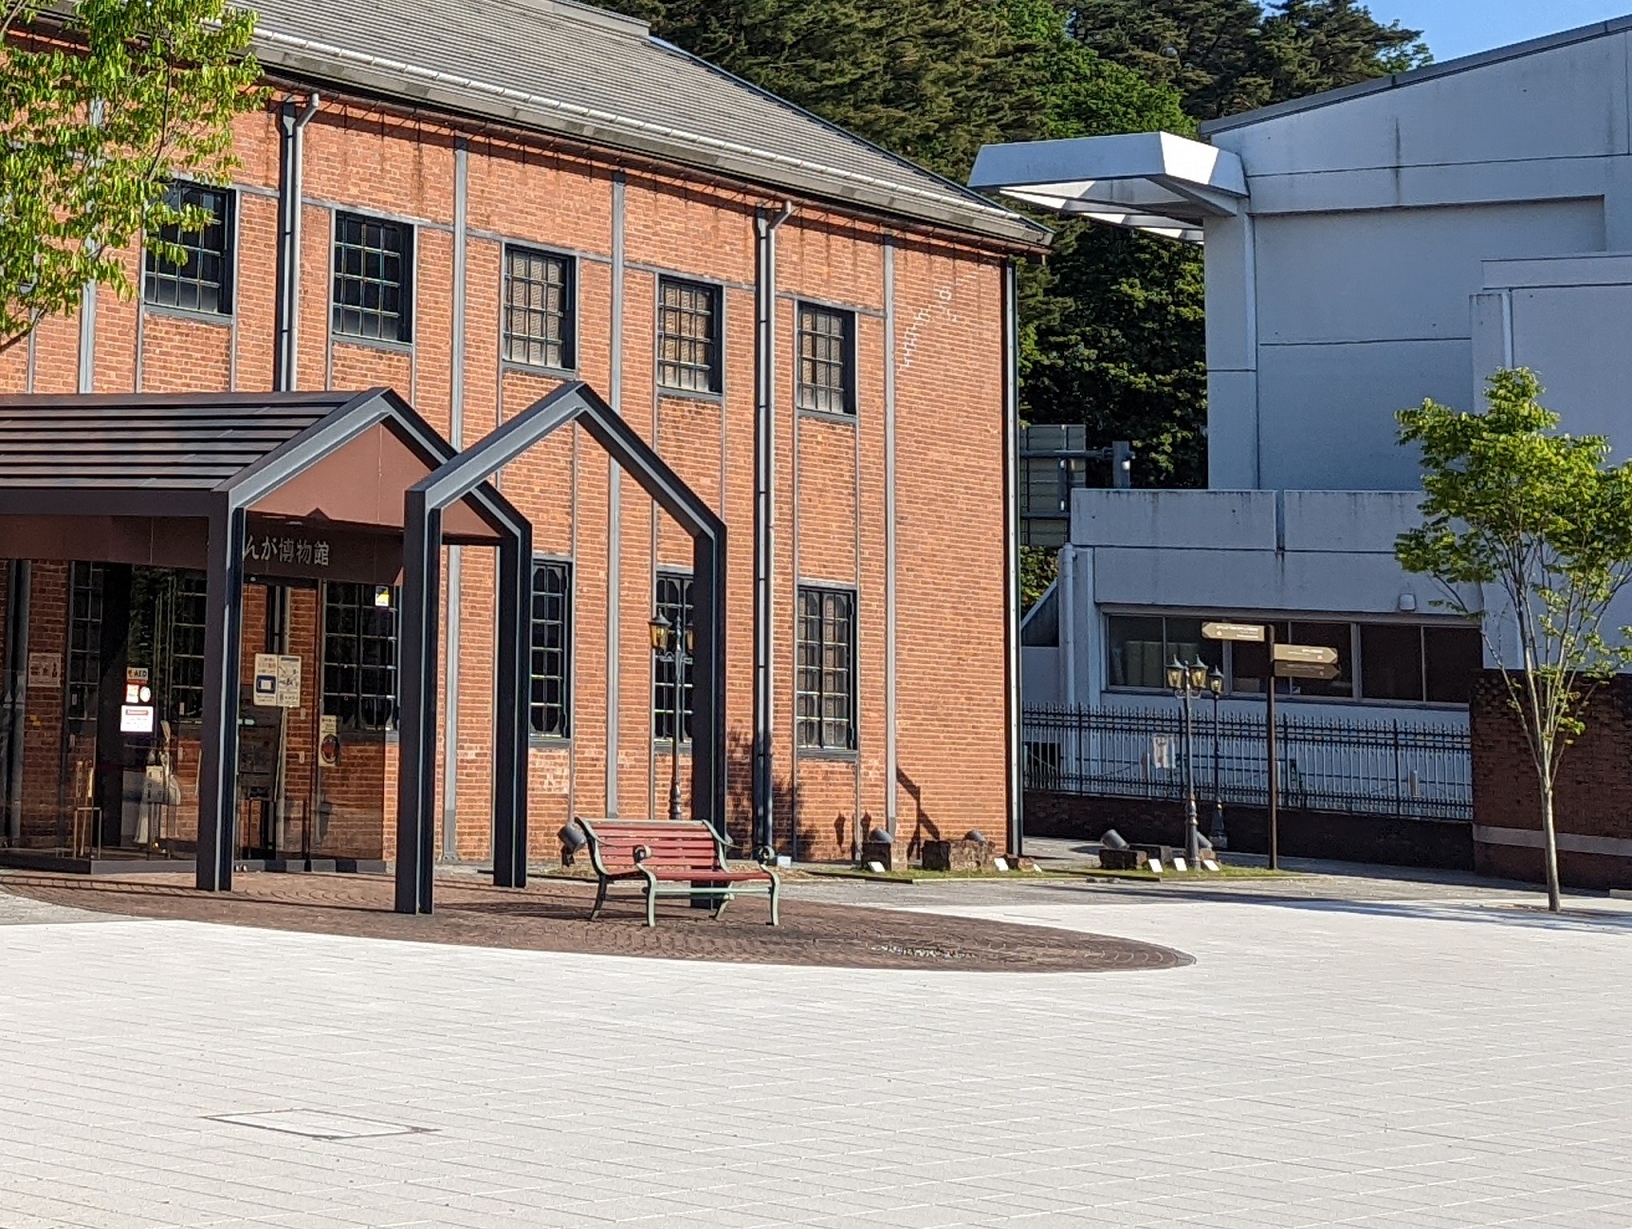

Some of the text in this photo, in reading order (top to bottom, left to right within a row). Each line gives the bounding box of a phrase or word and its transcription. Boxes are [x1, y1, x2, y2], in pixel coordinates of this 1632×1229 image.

[206, 534, 330, 566] んが博物館
